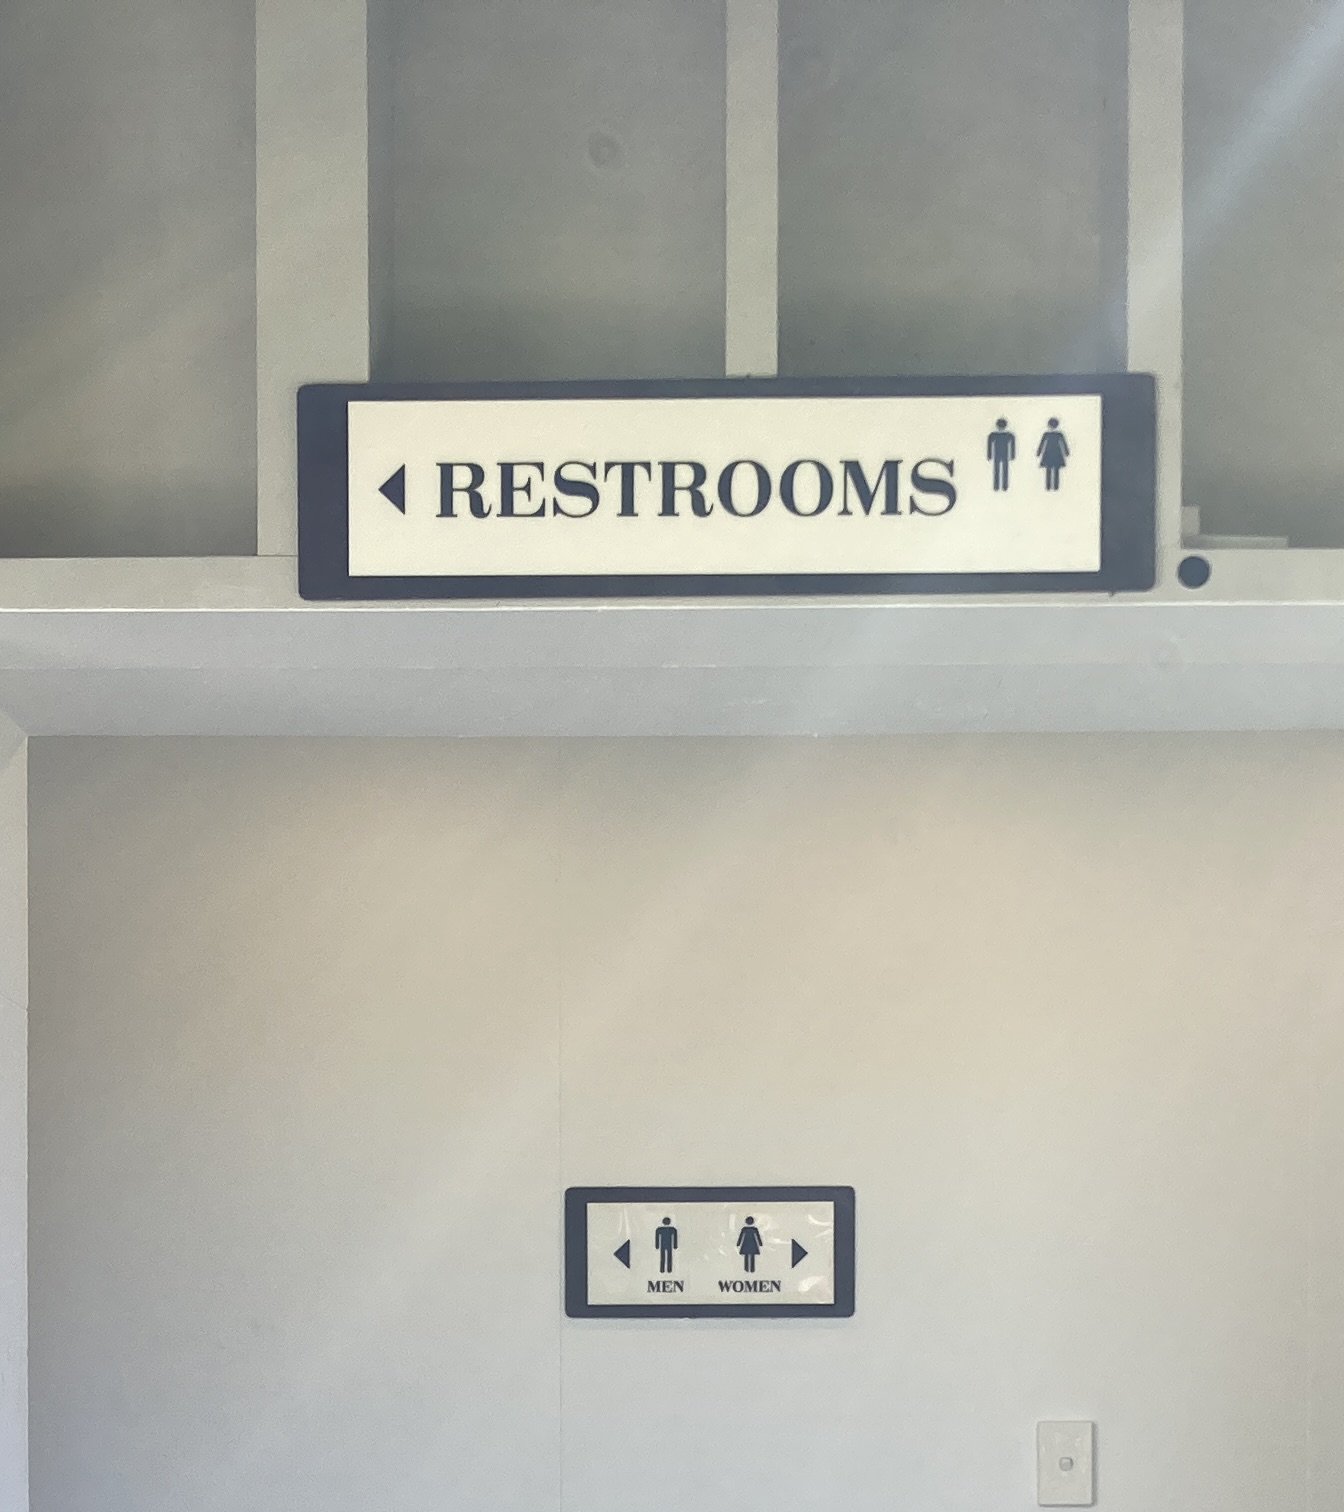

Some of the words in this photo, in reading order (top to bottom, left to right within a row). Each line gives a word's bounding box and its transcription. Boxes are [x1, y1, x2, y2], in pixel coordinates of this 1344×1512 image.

[434, 458, 958, 520] RESTROOMS
[646, 1279, 685, 1294] MEN
[717, 1279, 782, 1294] WOMEN
